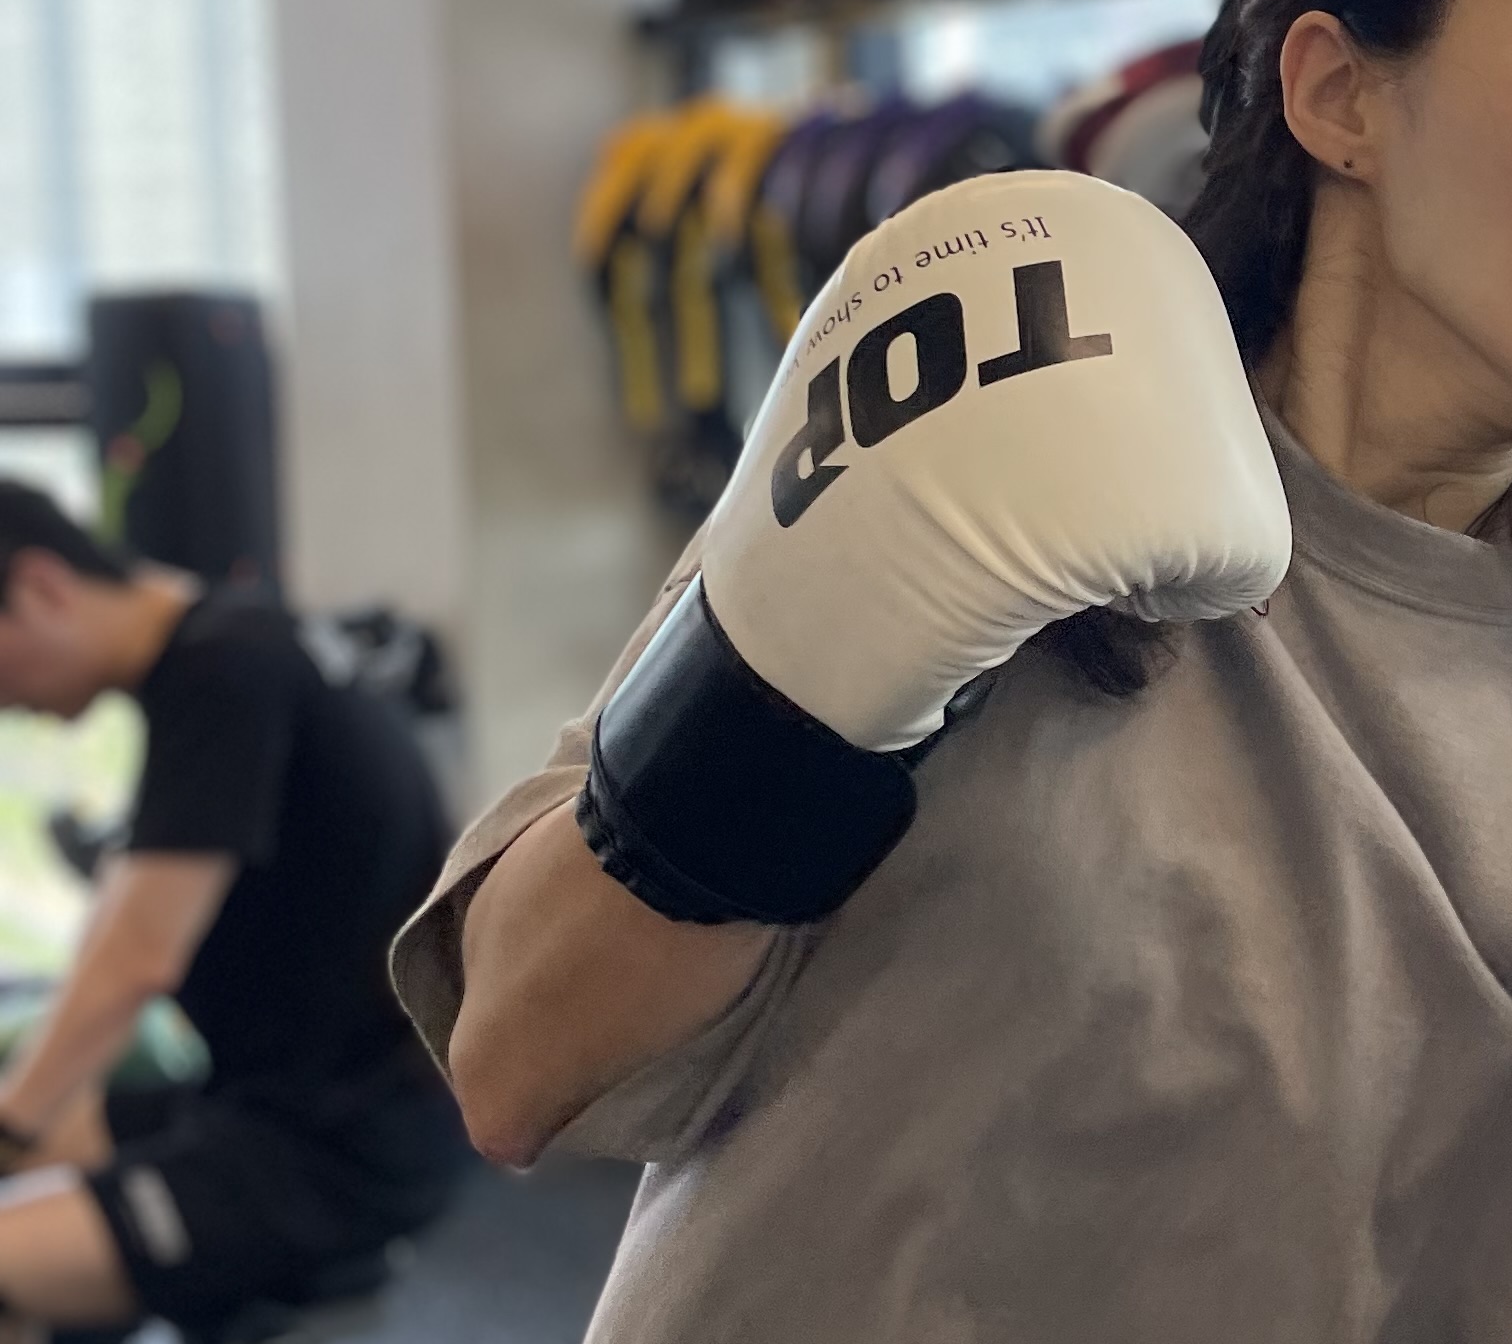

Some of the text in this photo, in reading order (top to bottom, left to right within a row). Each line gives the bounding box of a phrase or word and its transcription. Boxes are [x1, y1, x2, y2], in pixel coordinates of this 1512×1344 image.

[806, 216, 1053, 356] It's time to show
[771, 259, 1113, 529] TOP
